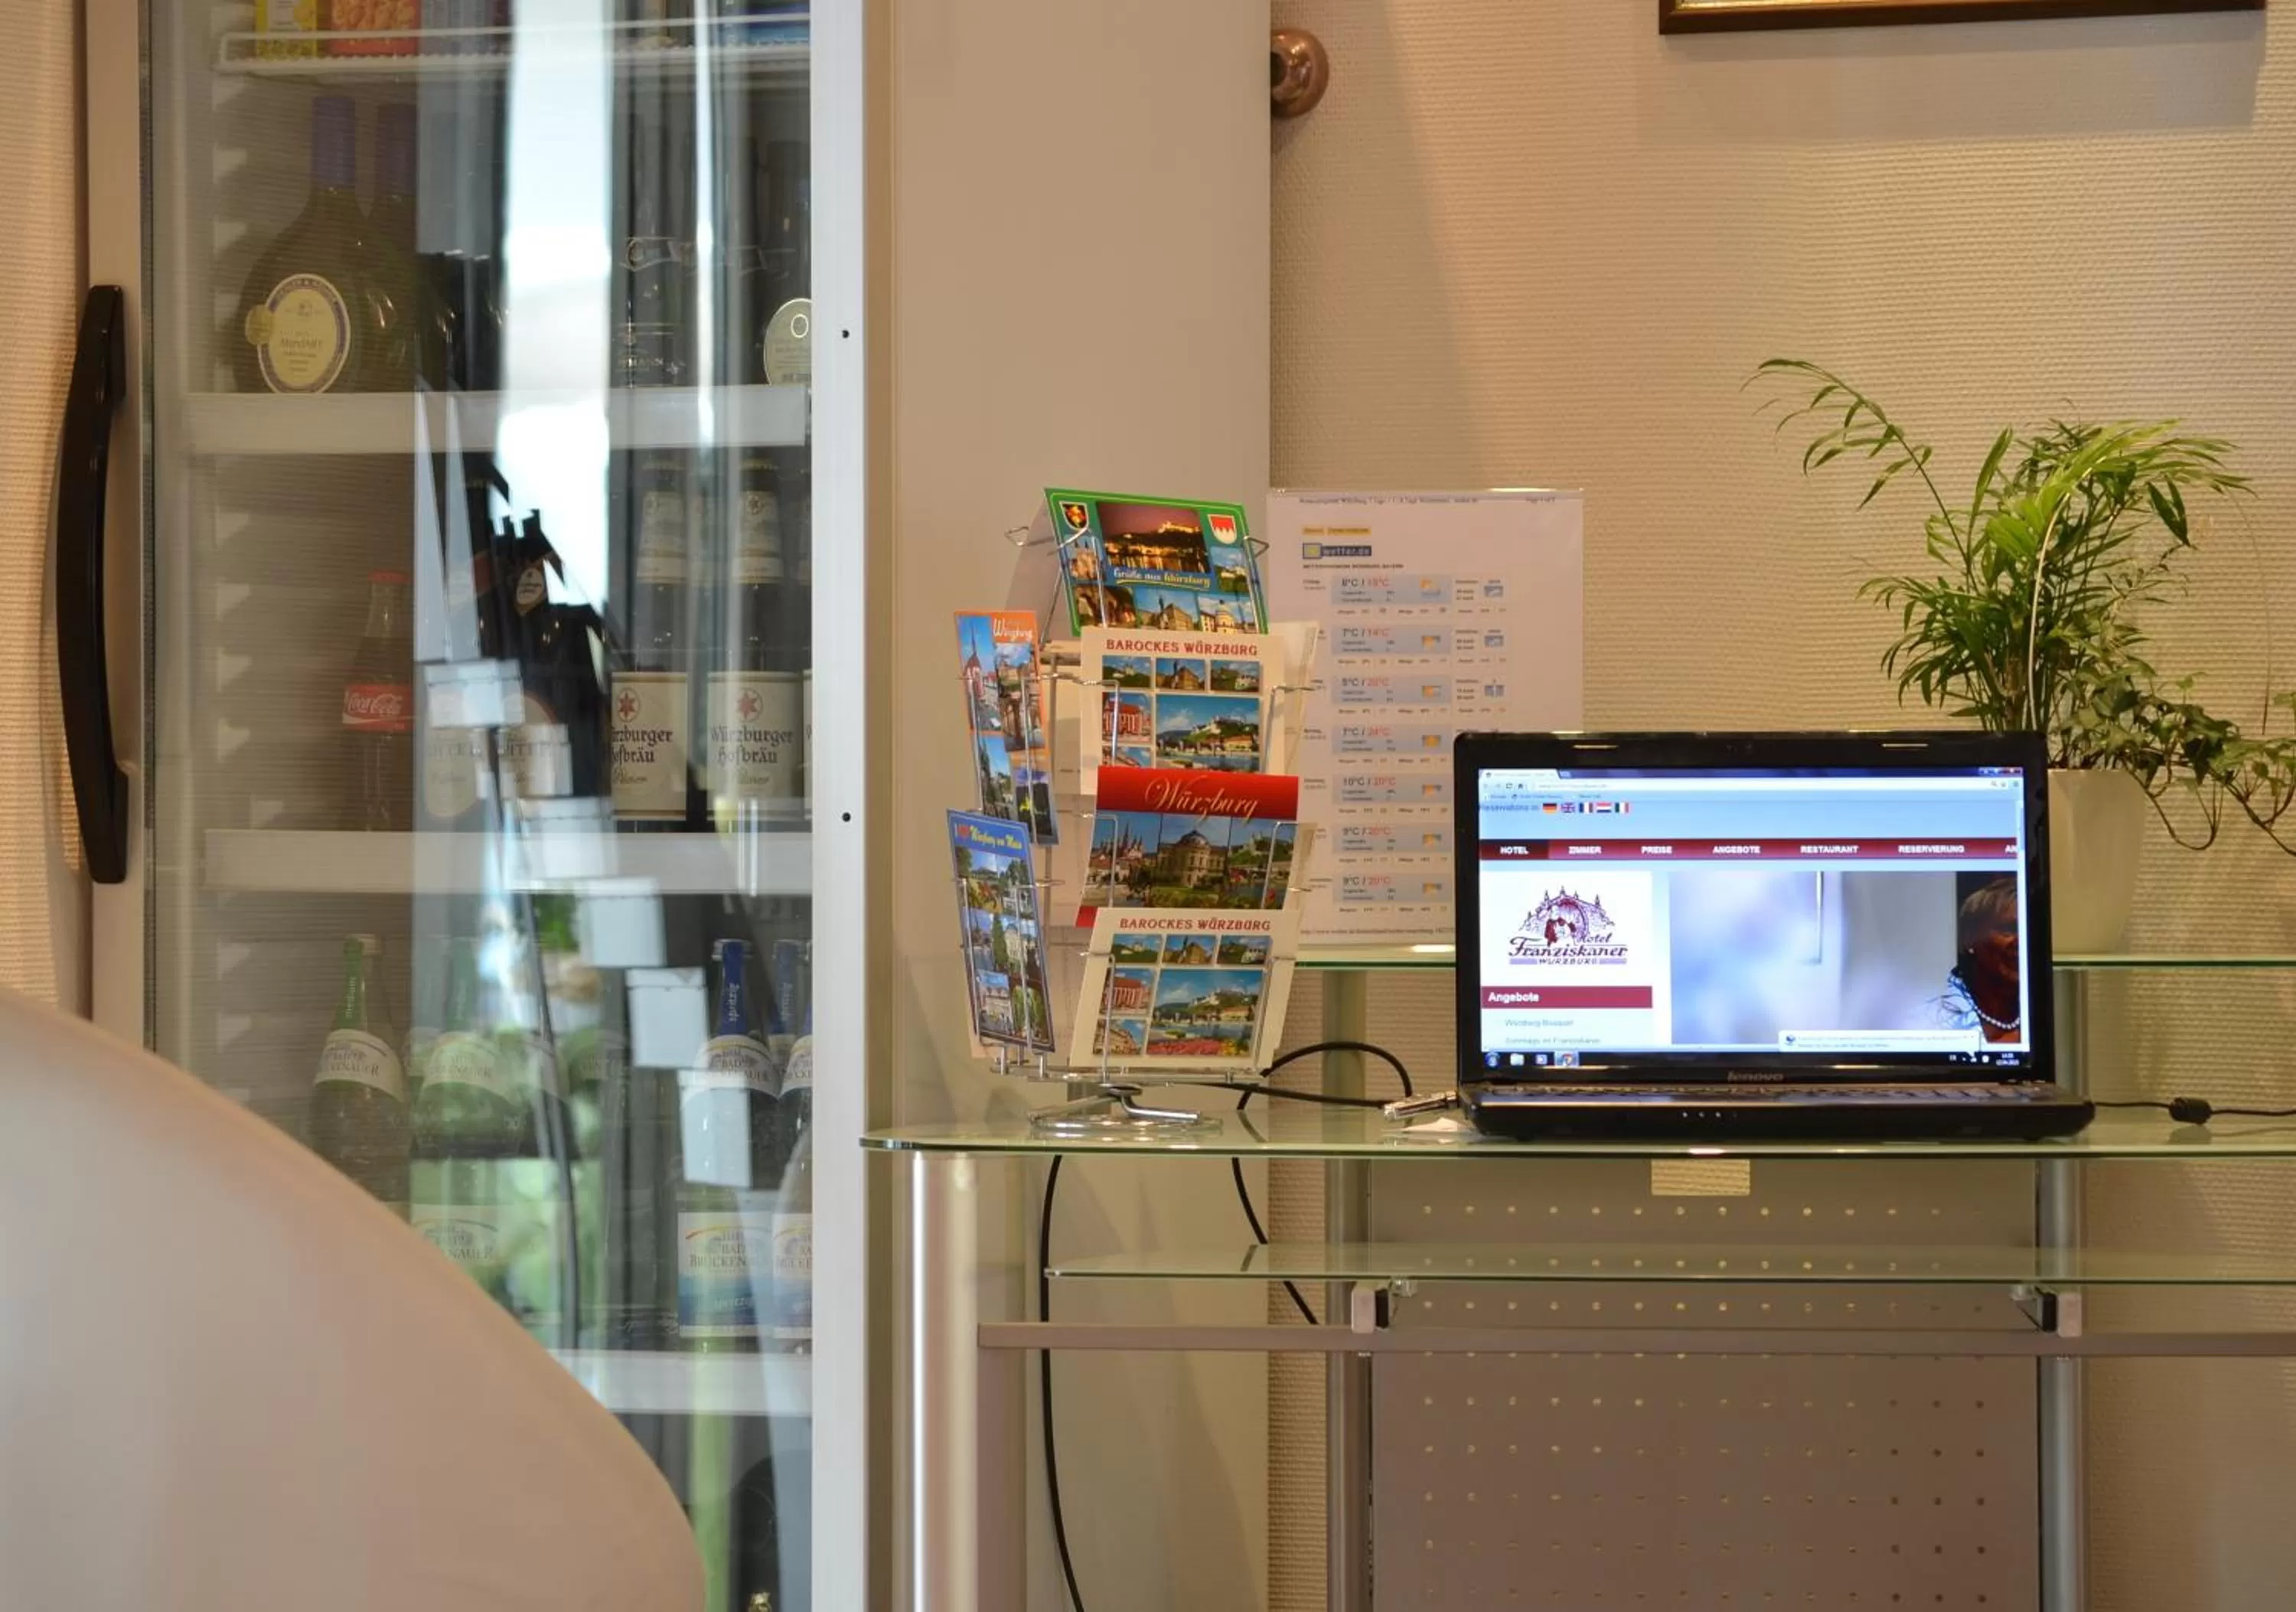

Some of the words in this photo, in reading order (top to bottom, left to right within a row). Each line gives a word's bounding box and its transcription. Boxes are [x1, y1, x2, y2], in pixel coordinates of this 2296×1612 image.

[1106, 638, 1179, 653] BAROCKES
[1184, 641, 1257, 656] WÜRZBURG
[612, 726, 673, 747] rzburger
[710, 725, 794, 747] Würzburger
[612, 745, 655, 765] ofbräu
[717, 745, 778, 765] Hofbräu
[1145, 775, 1259, 827] Würzburg
[1500, 846, 1529, 855] HOTEL
[1568, 846, 1602, 855] ZIMMER
[1641, 846, 1673, 855] PREISE
[1712, 846, 1760, 854] ANGEBOTE
[1800, 845, 1859, 853] RESTAURANT
[1898, 845, 1965, 853] RESERVIERUNG
[1120, 918, 1193, 929] BAROCKES
[1197, 917, 1271, 931] WÜRZBURG
[1508, 936, 1628, 957] Franziskaner
[1577, 932, 1613, 943] Hotel
[1488, 992, 1540, 1003] Angebote
